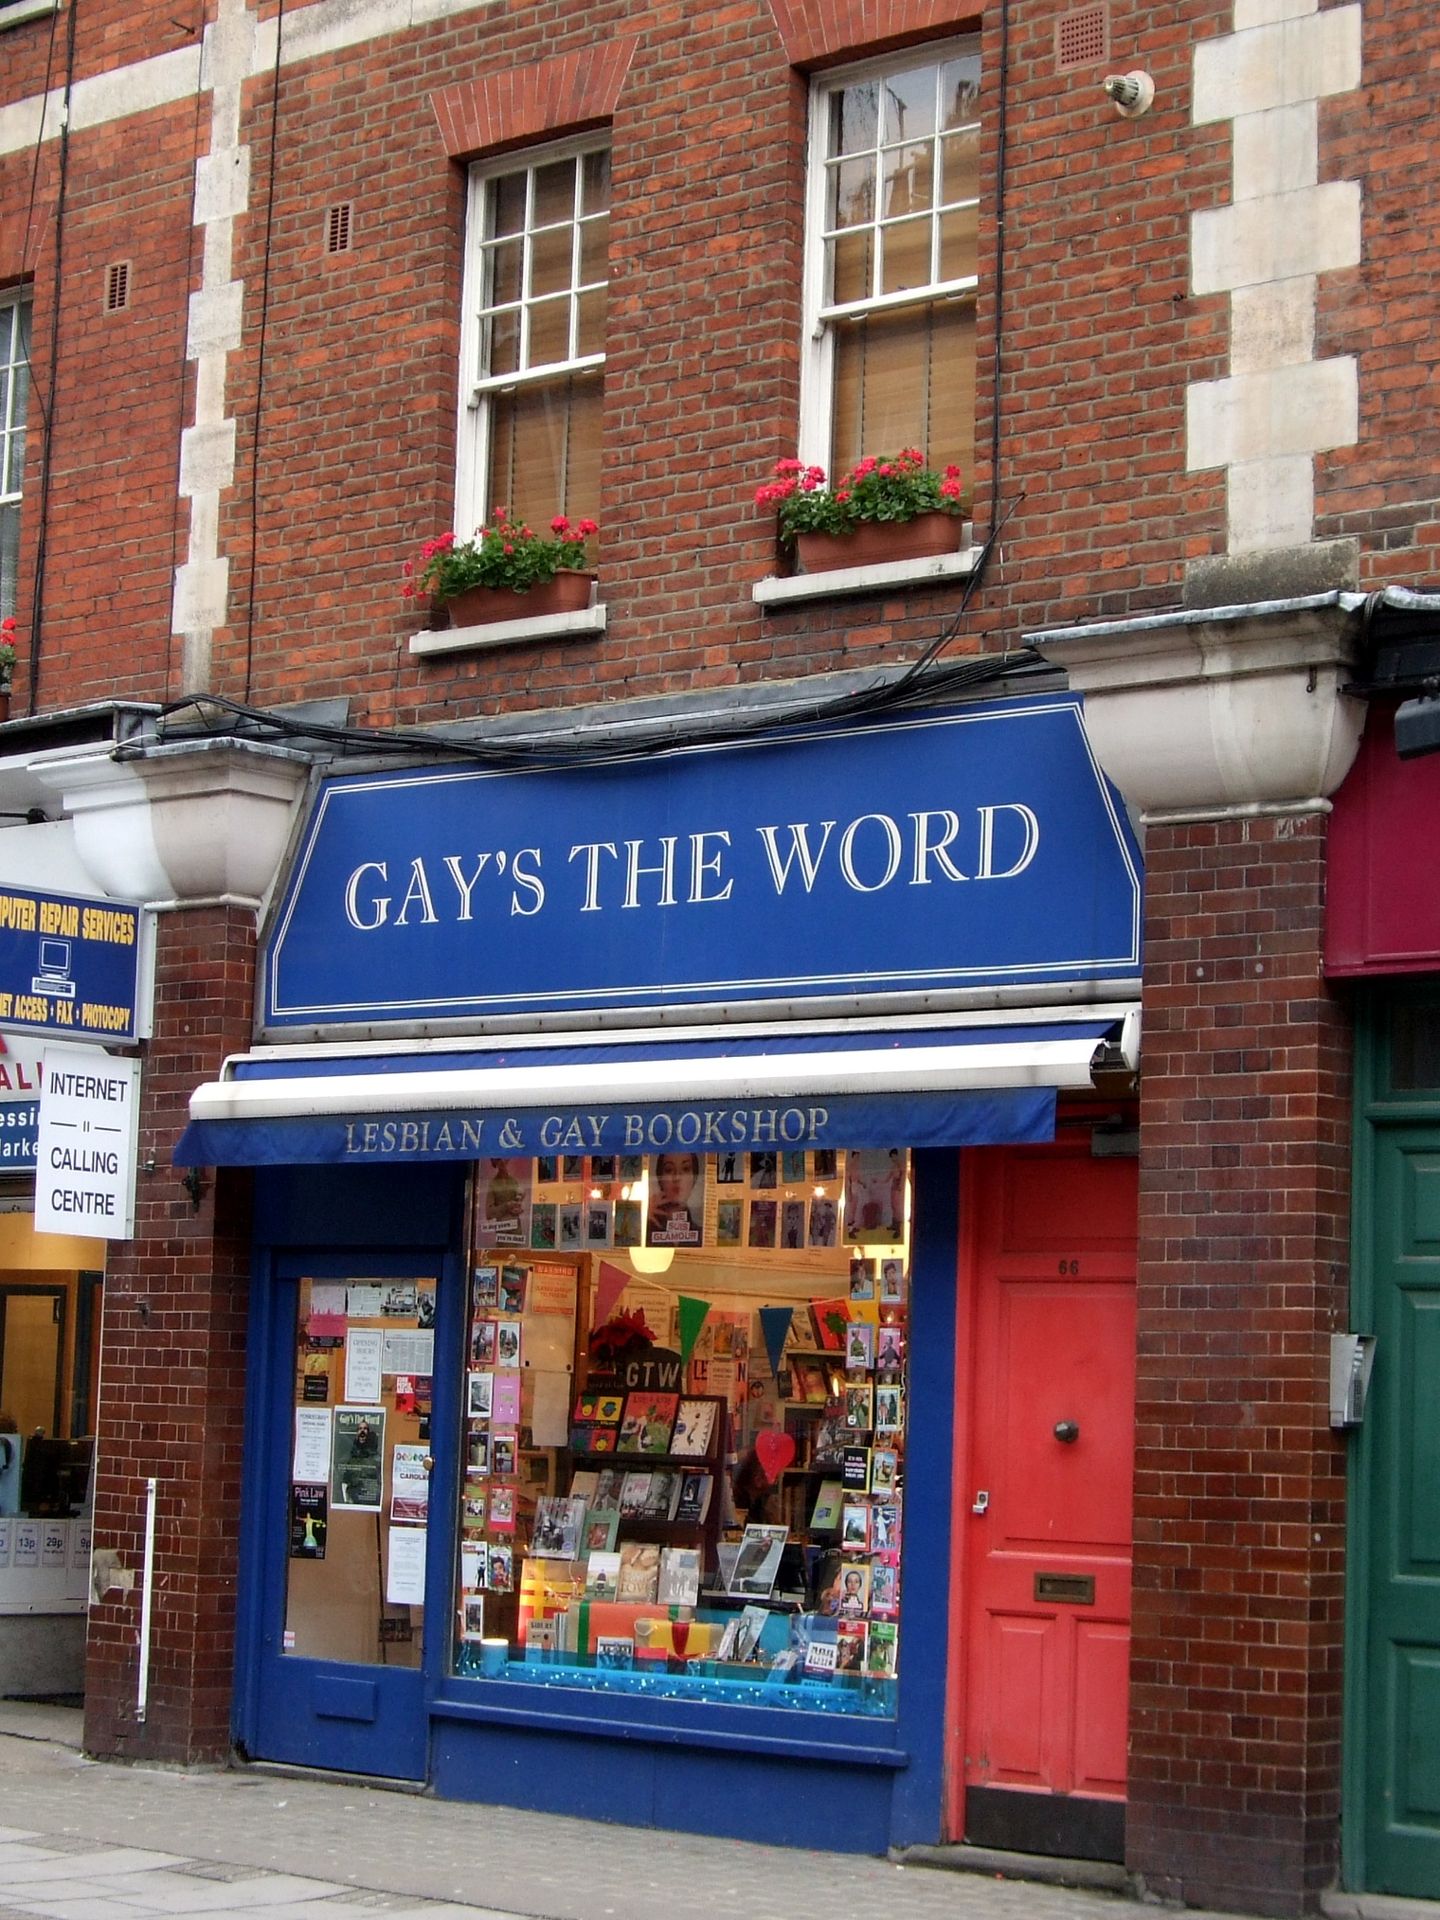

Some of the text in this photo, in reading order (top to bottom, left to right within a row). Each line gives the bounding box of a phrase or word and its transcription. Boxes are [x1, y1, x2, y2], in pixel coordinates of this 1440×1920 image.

[345, 803, 1040, 930] GAY'S THE WORD
[0, 895, 135, 945] PUTER REPAIR SERVICES
[0, 992, 131, 1031] ET ACCESS FAX PHOTOCOPY
[50, 1071, 128, 1102] INTERNET
[346, 1107, 830, 1154] LESBIAN & GAY BOOKSHOP
[51, 1147, 118, 1175] CALLING
[51, 1189, 115, 1216] CENTRE
[1058, 1260, 1080, 1275] 66
[295, 1487, 325, 1498] Pink Law
[20, 1537, 35, 1549] 13p
